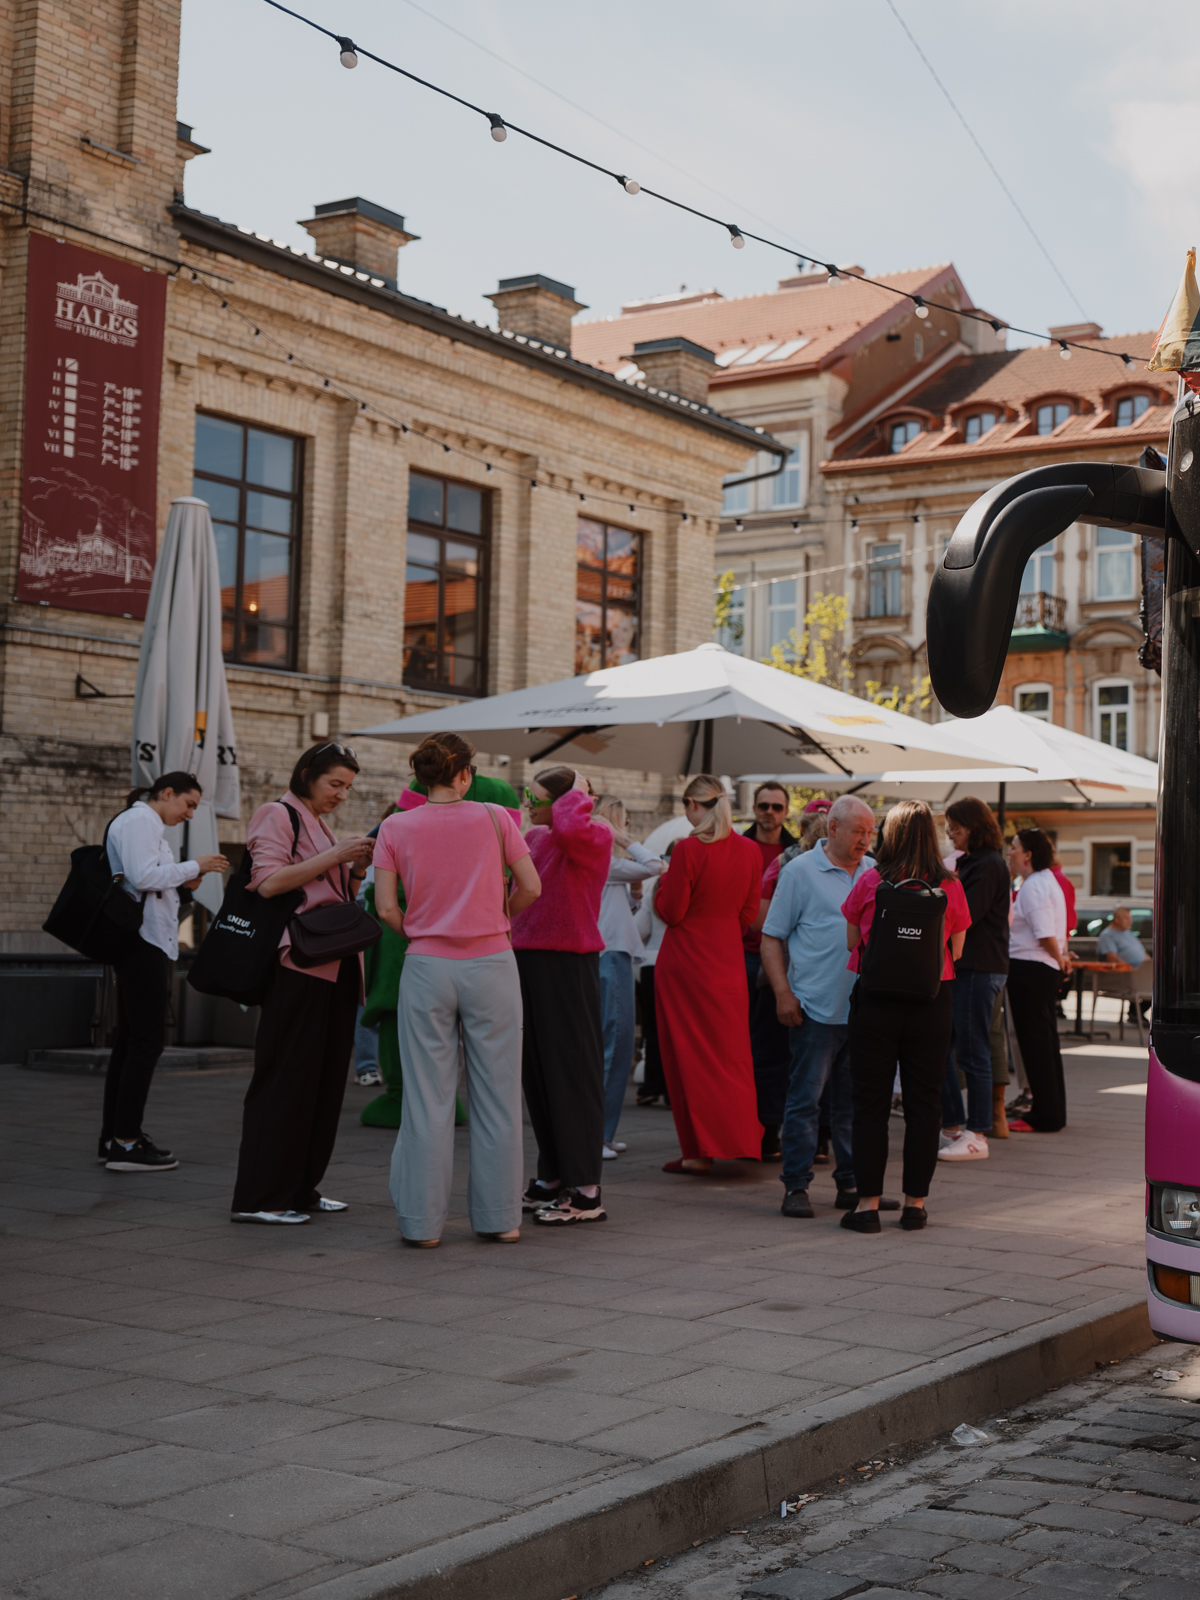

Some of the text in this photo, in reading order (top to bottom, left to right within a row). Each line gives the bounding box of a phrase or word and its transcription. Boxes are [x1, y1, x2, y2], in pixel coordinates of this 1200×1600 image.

[54, 297, 138, 338] HALES
[74, 323, 118, 345] TURGUS
[48, 400, 60, 409] IV
[51, 414, 60, 424] V
[47, 428, 60, 439] VI
[43, 442, 60, 454] VII
